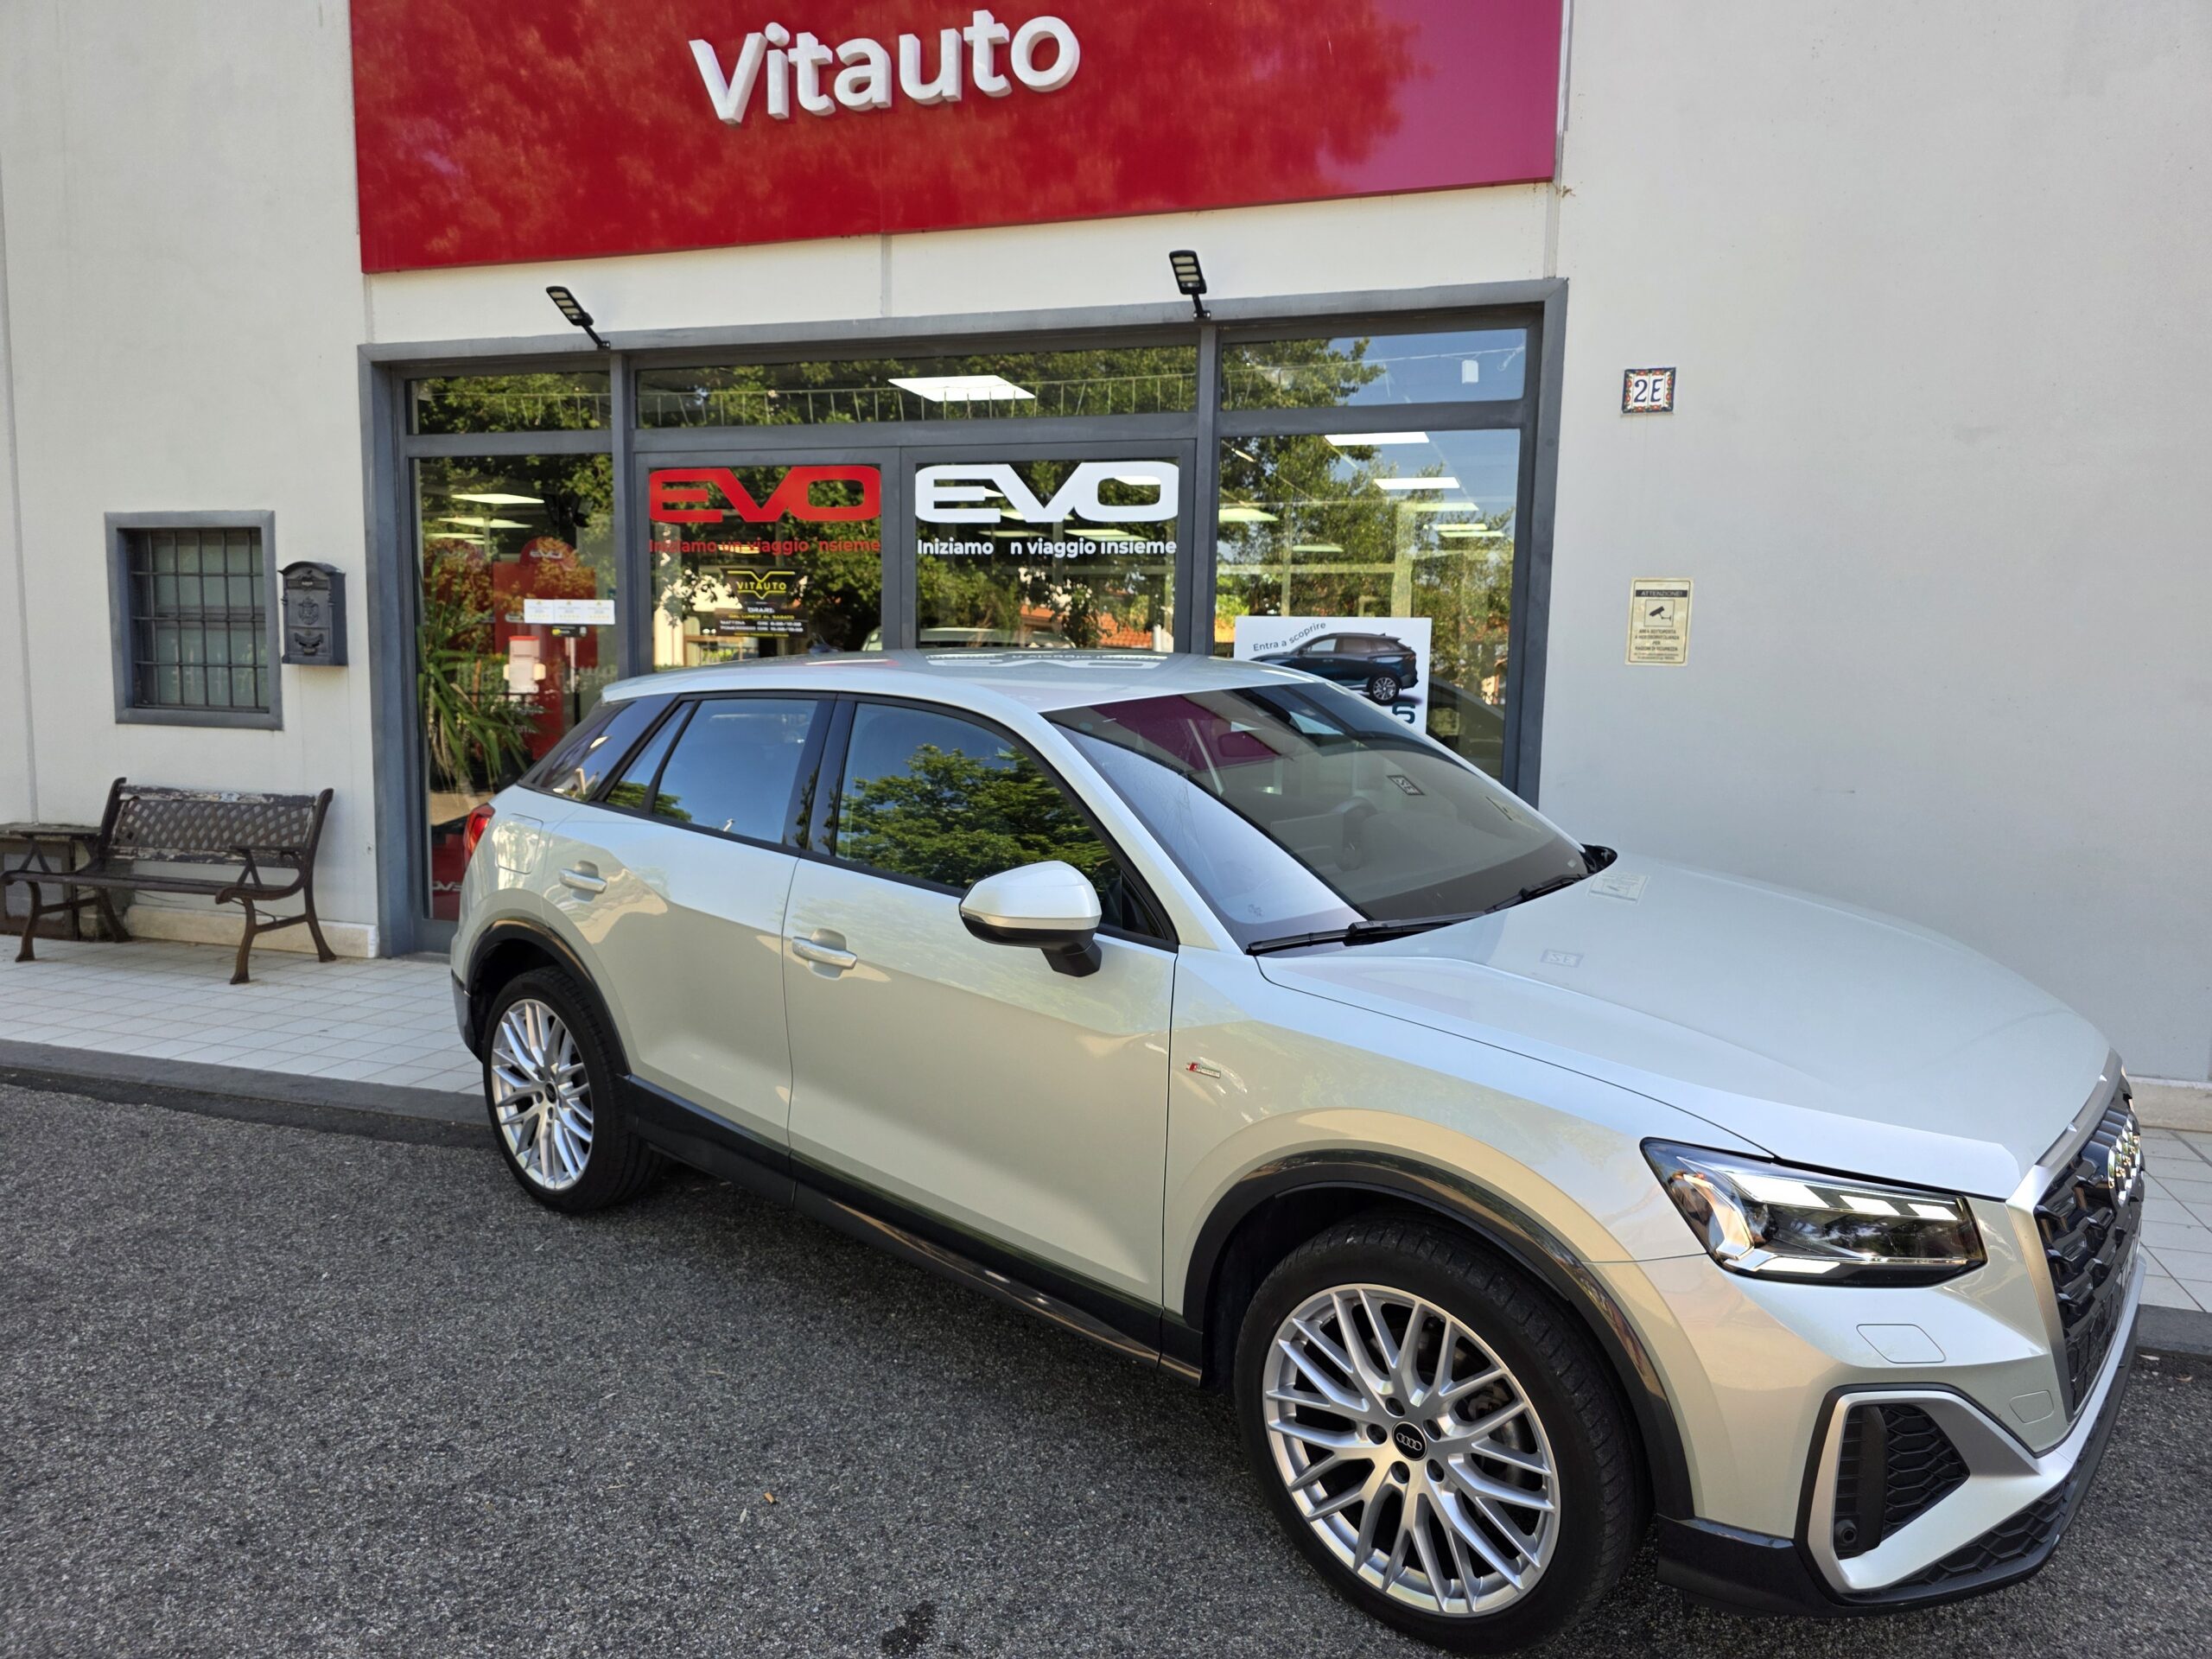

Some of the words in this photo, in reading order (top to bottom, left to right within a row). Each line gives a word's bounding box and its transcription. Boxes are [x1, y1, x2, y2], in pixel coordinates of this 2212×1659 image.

[689, 10, 1080, 124] Vitauto
[1633, 378, 1663, 403] 2E
[650, 465, 880, 523] EVO
[915, 461, 1179, 523] EVO
[650, 537, 717, 553] Iniziamo
[747, 536, 810, 556] viaggio
[917, 537, 995, 555] Iniziamo
[1027, 537, 1096, 558] viaggio
[1100, 536, 1177, 555] insieme
[736, 581, 787, 590] VITAUTO
[1253, 641, 1279, 652] Entra
[1289, 622, 1326, 644] scoprire
